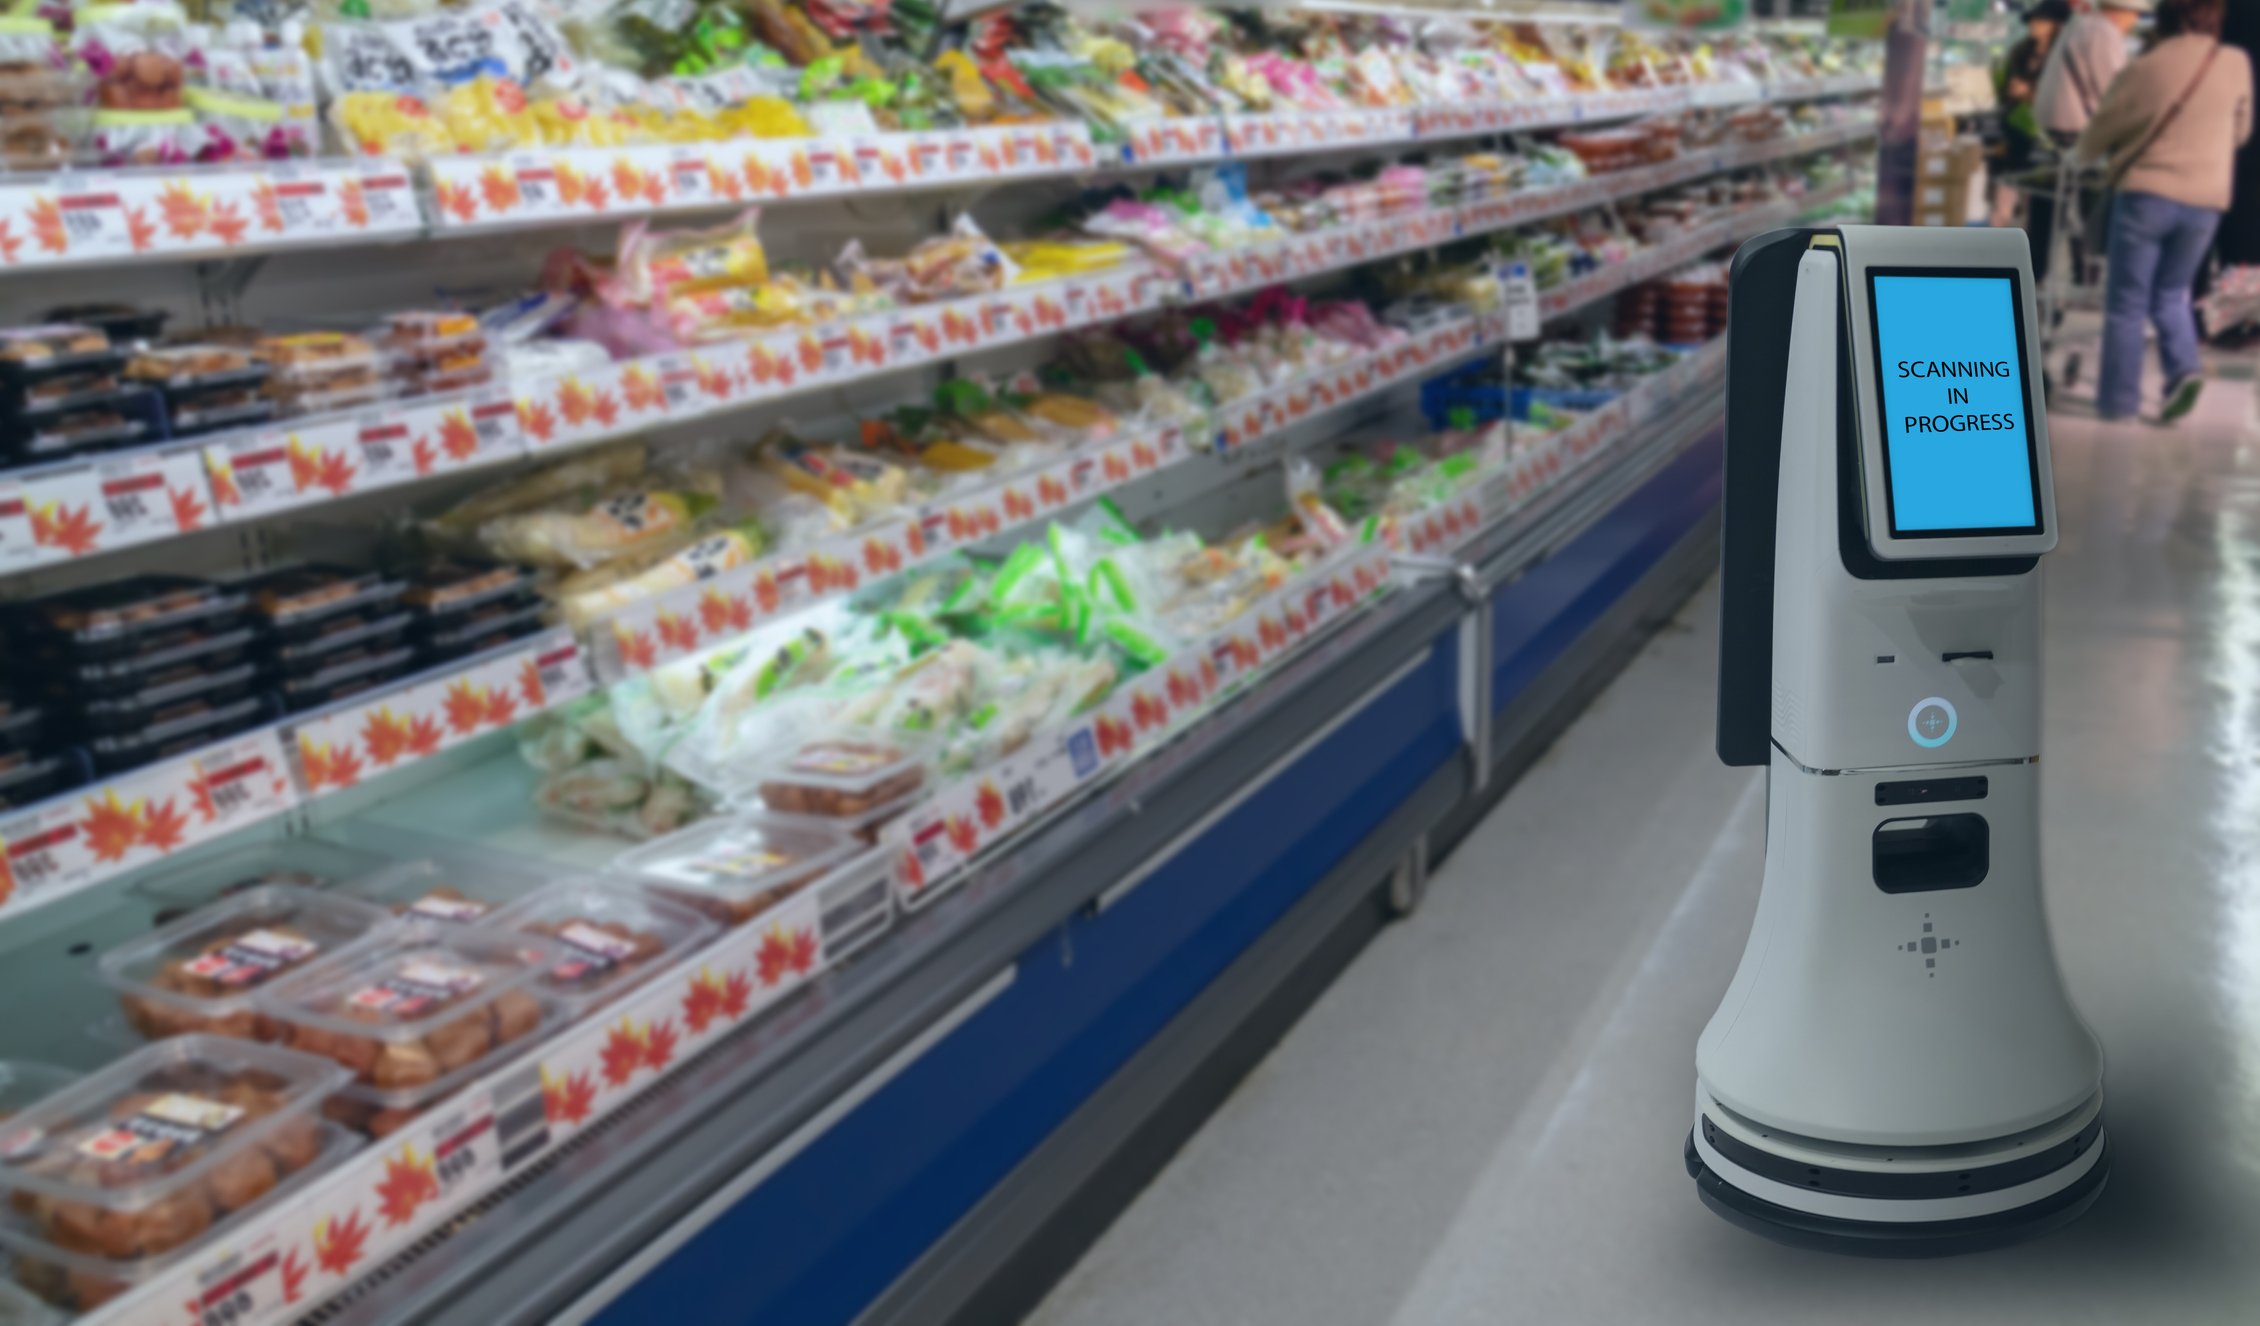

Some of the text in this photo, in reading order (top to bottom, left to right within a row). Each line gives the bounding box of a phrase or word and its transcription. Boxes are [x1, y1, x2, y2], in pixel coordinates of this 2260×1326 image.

[1898, 361, 2009, 378] SCANNING
[1948, 388, 1968, 404] IN
[1905, 414, 2014, 433] PROGRESS
